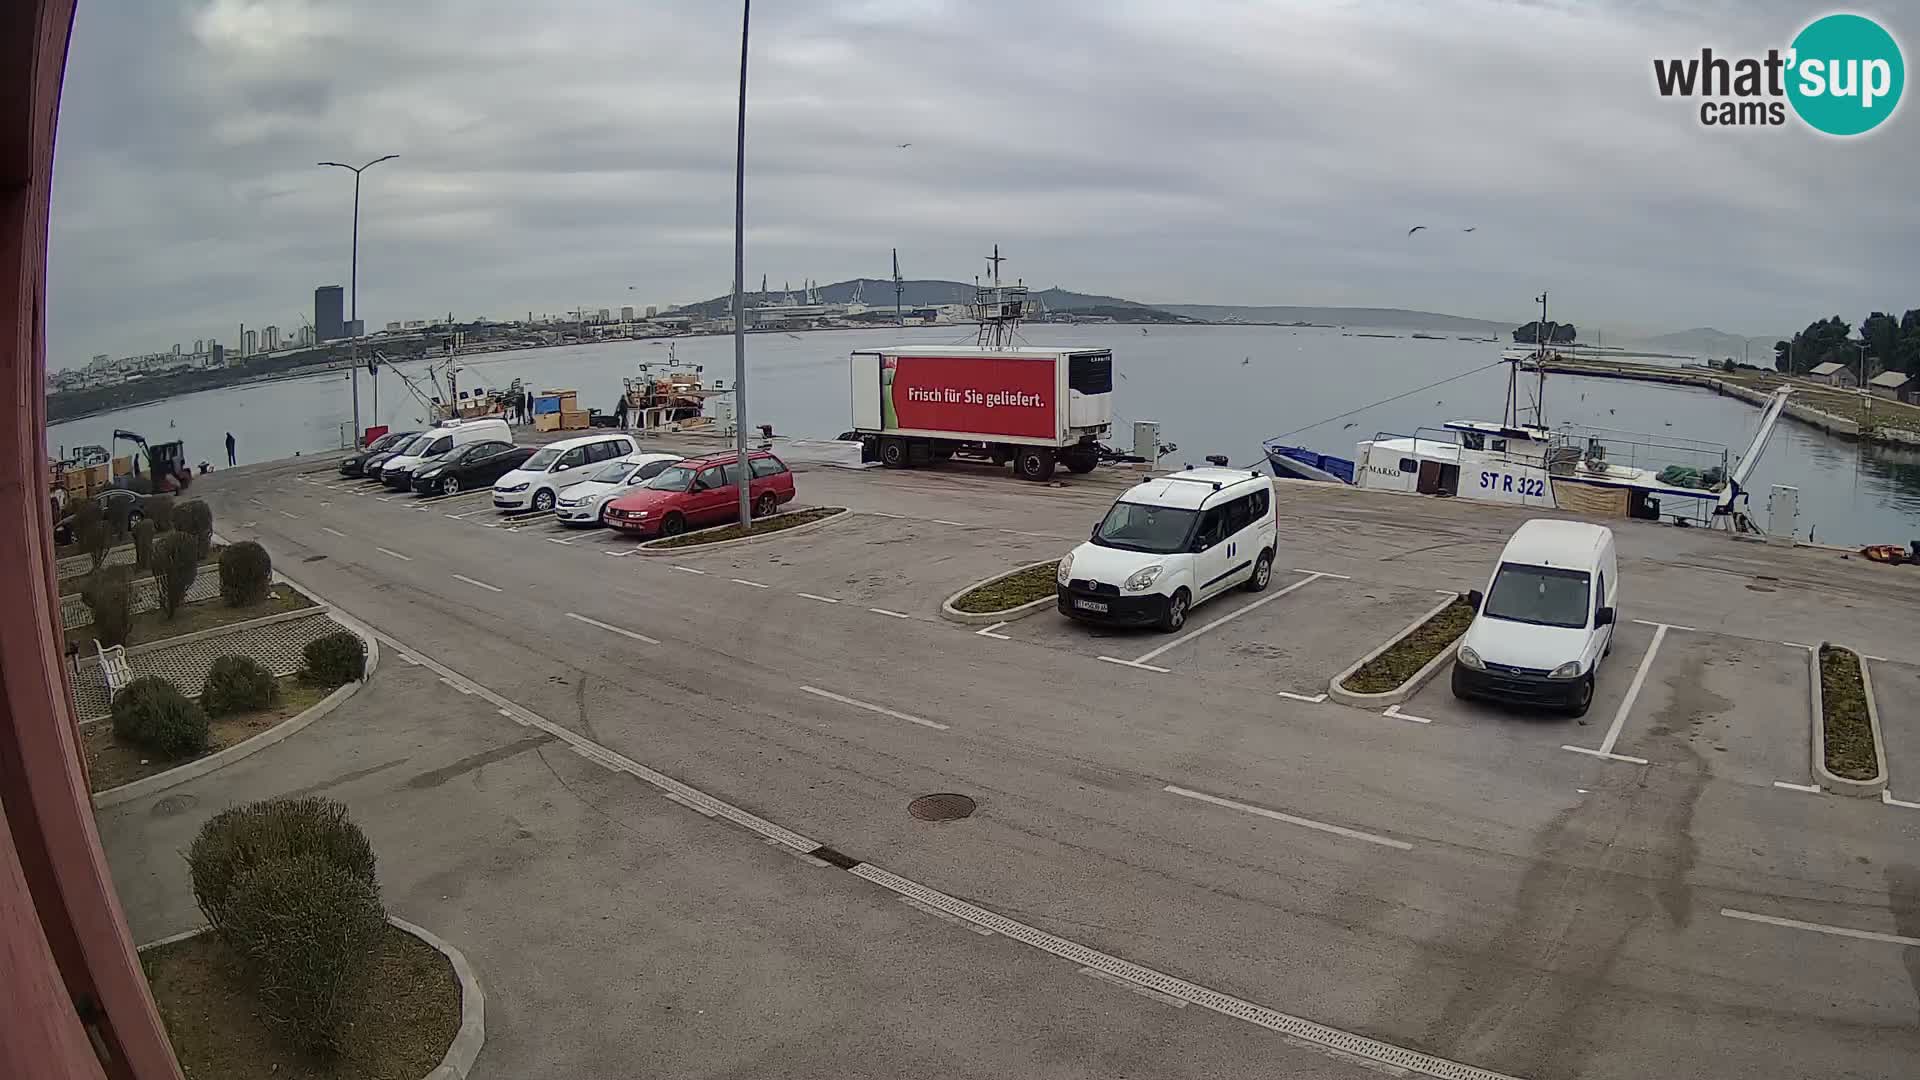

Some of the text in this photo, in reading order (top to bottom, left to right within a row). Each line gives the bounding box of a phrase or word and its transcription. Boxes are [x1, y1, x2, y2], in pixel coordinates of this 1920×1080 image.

[908, 387, 1044, 407] Frisch für Sie geliefert.
[1368, 465, 1401, 478] MARKO
[1480, 471, 1543, 497] ST R 322
